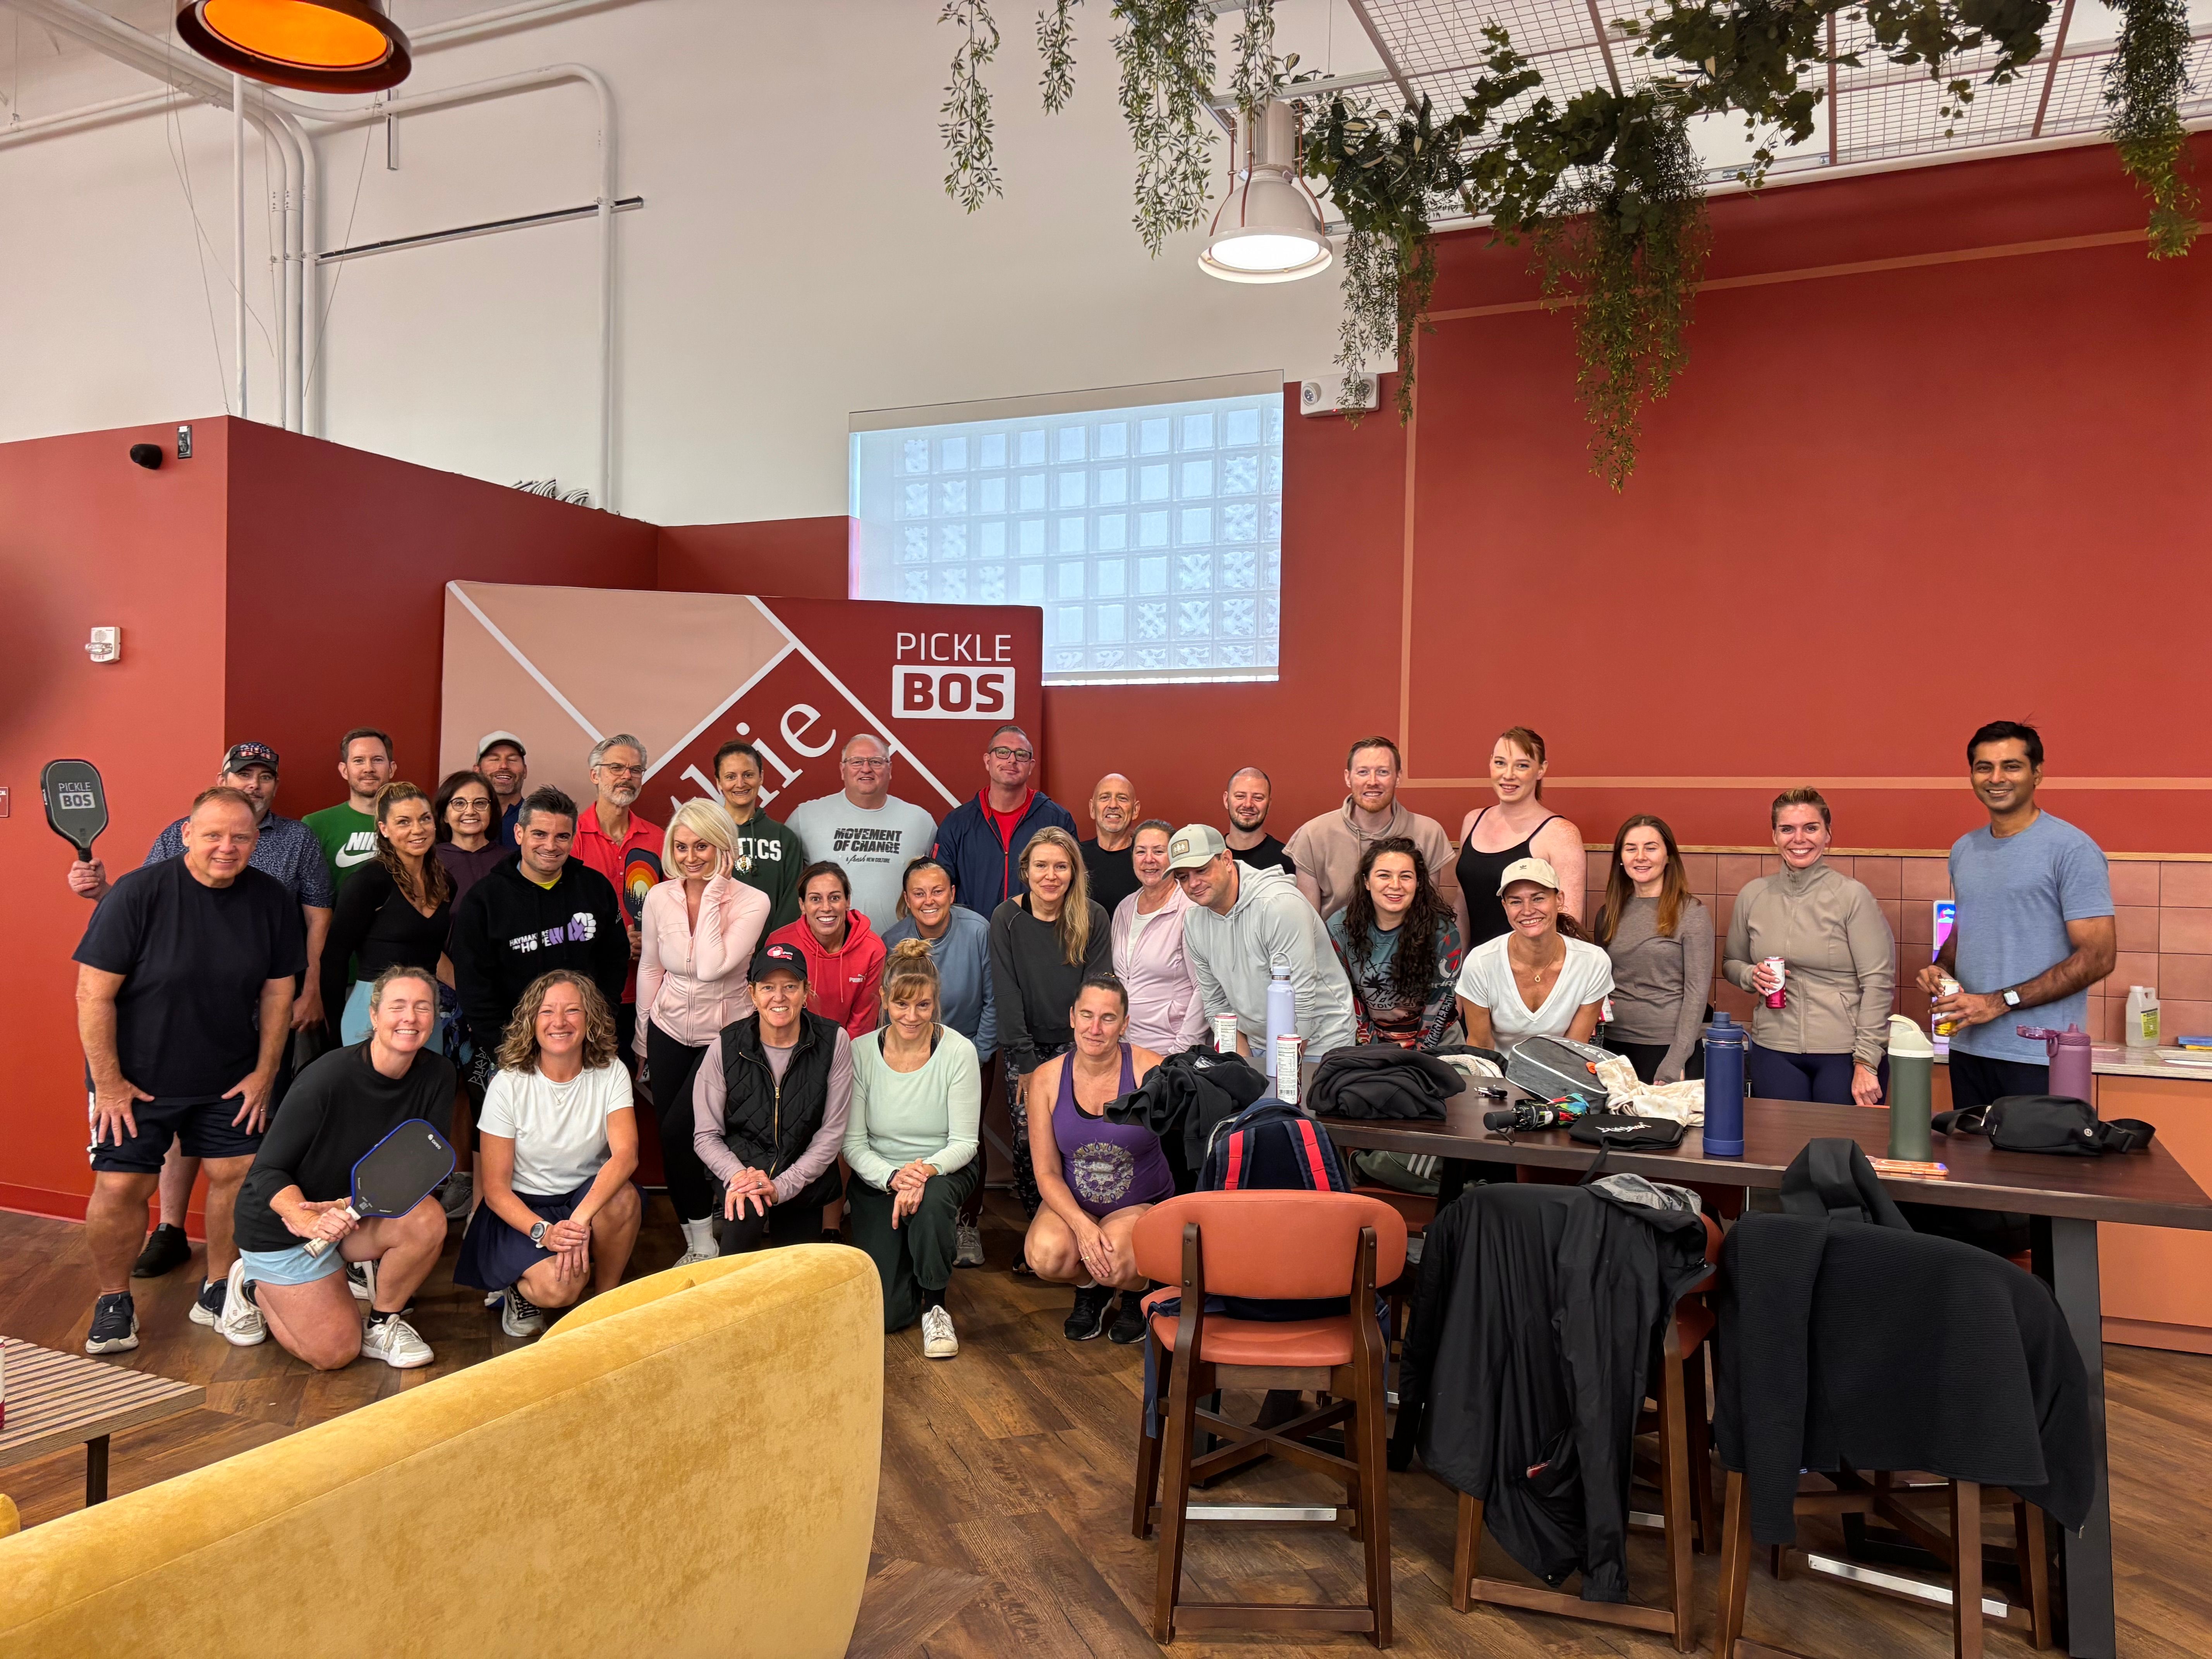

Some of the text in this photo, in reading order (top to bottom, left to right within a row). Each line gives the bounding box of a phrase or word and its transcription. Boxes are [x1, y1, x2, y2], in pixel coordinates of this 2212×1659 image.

[897, 632, 1011, 661] PICKLE
[903, 673, 1004, 713] BOS
[58, 782, 92, 792] PICKLE
[62, 794, 92, 807] BOS
[833, 828, 902, 842] MOVEMENT
[833, 840, 900, 854] OF CHANGE
[509, 930, 549, 947] HAYMAKRS
